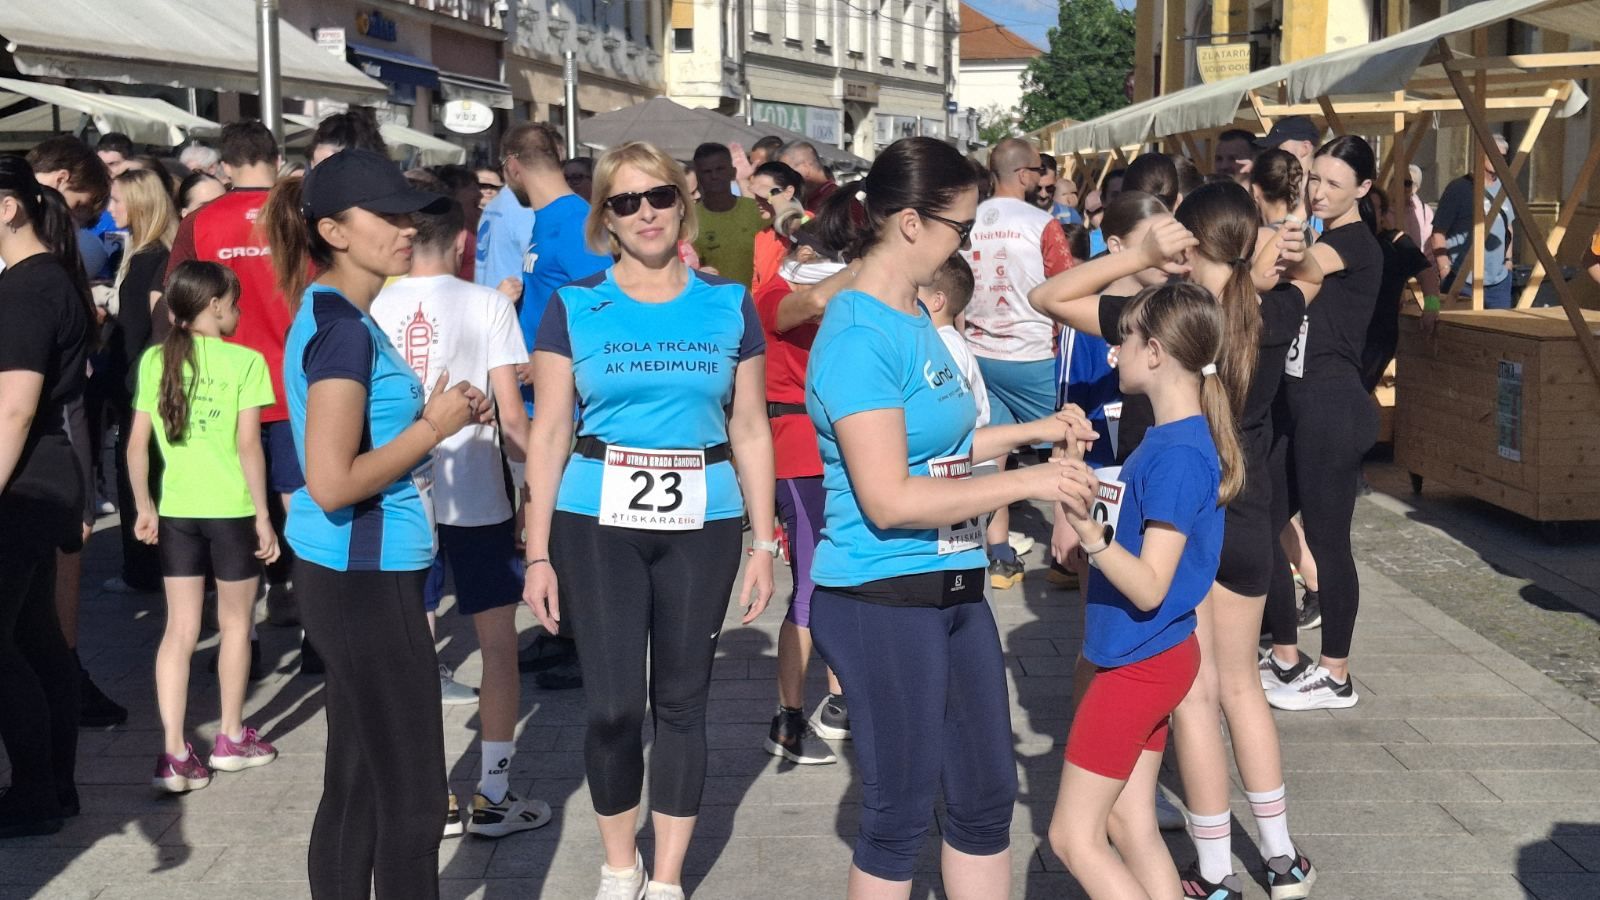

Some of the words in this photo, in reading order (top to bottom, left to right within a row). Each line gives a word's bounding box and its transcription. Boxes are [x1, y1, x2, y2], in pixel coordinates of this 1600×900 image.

[974, 230, 1021, 241] VisitMalta
[218, 246, 272, 260] CROA
[603, 341, 652, 354] ŠKOLA
[656, 339, 721, 355] TRČANJA
[605, 362, 625, 374] AK
[630, 360, 720, 375] MEĐIMURJE
[628, 470, 683, 513] 23
[620, 513, 676, 524] TISKARA
